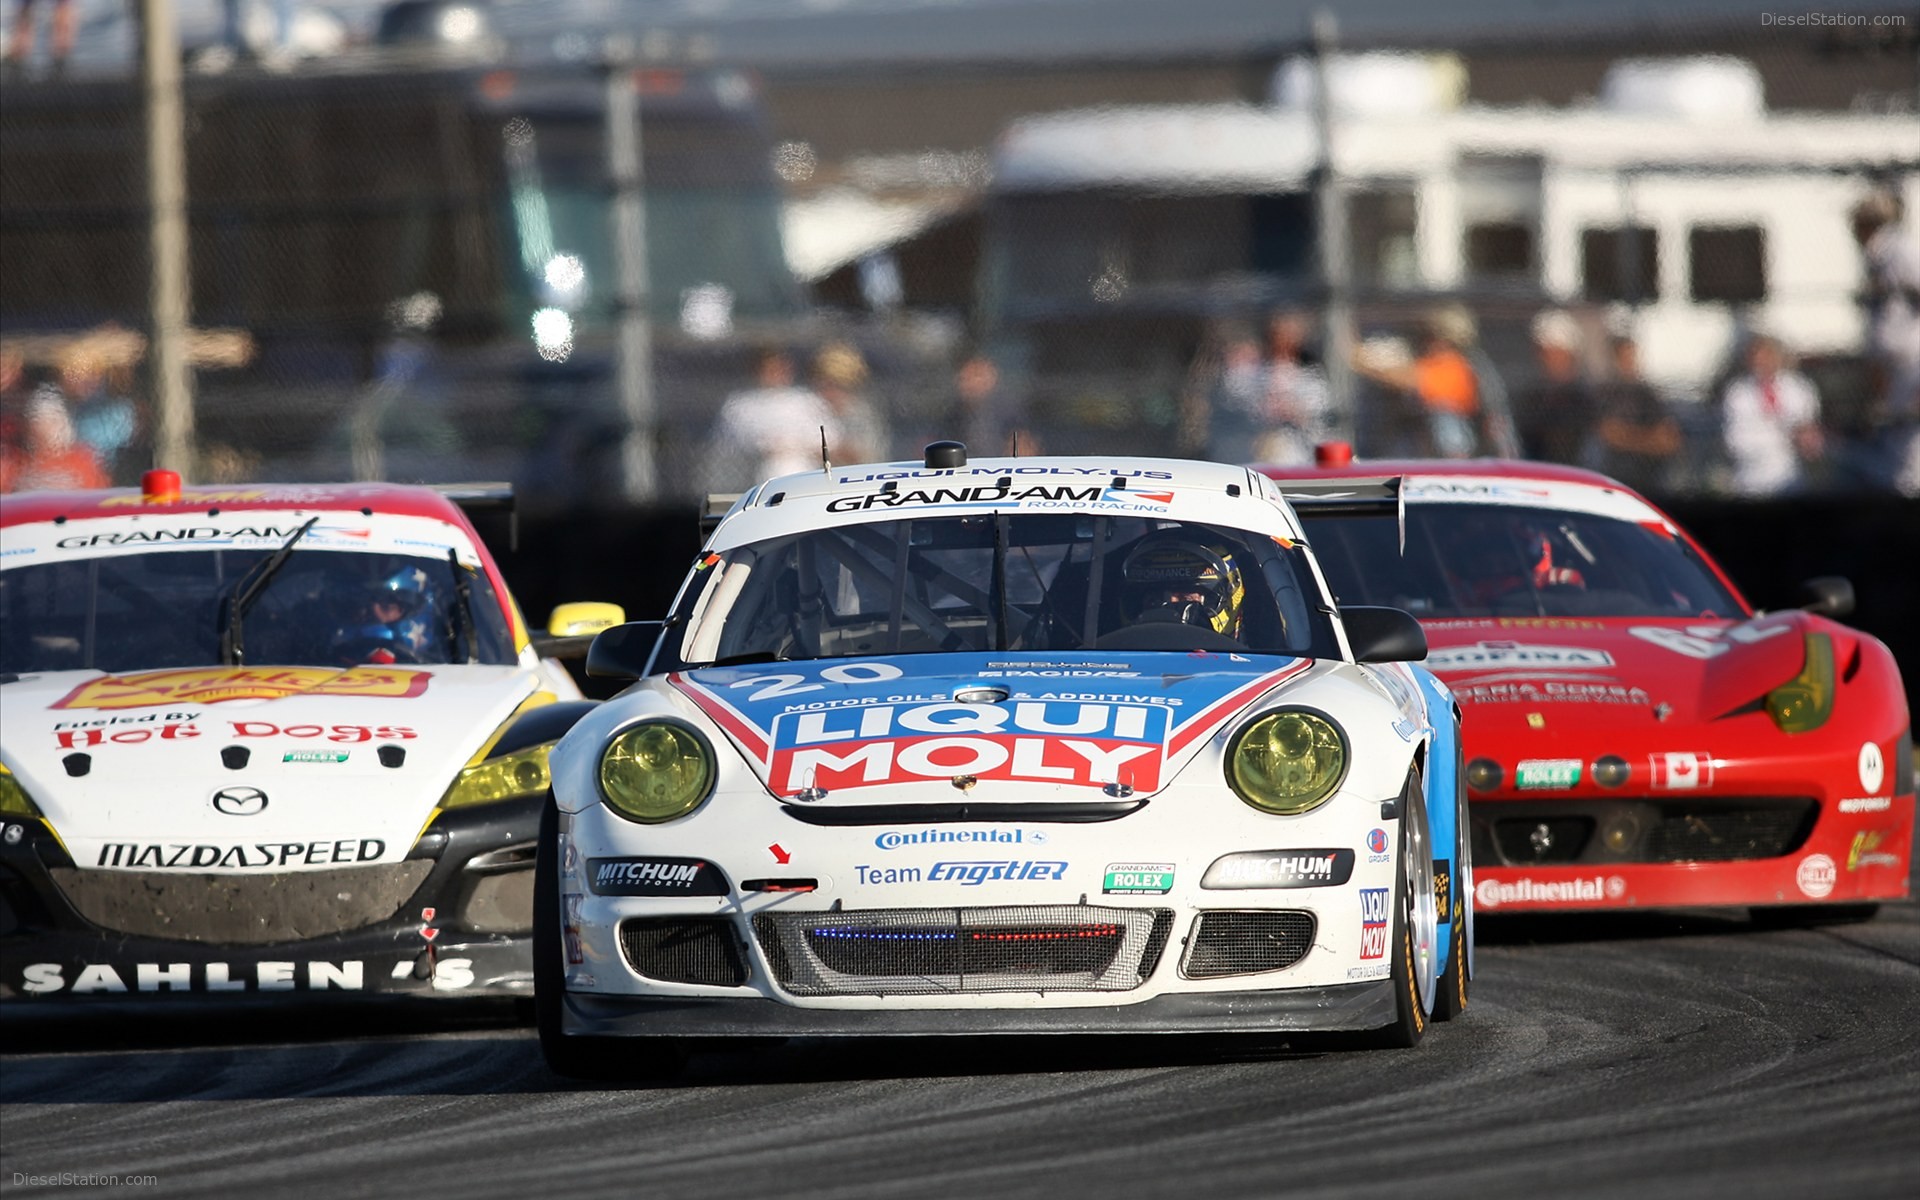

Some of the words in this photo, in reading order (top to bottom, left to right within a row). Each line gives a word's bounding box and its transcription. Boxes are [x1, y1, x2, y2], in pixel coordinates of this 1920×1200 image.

[838, 466, 1173, 485] LIQUI-MOLY.US
[825, 486, 1099, 513] GRAND-AM
[1026, 501, 1087, 509] ROAD
[1090, 501, 1169, 514] RACING
[56, 525, 303, 549] GRAND-AM
[729, 662, 904, 702] 20
[1006, 670, 1093, 678] PAGID
[784, 697, 879, 712] MOTOR
[886, 692, 948, 703] OILS
[1013, 691, 1031, 700] &
[1038, 692, 1184, 707] ADDITIVES
[54, 714, 157, 731] Fueled
[164, 712, 202, 721] By
[227, 721, 419, 743] Dogs
[795, 702, 1150, 745] LIQUI
[292, 752, 338, 762] ROLEX
[787, 738, 1157, 791] MOLY
[1523, 769, 1573, 786] ROLEX
[875, 828, 1023, 850] Continental
[97, 839, 387, 868] MAZDASPEED
[596, 862, 700, 882] MITCHUM
[854, 865, 922, 885] Team
[1221, 857, 1332, 876] MITCHUM
[595, 878, 693, 888] MOTORSPORTS
[1113, 873, 1164, 887] ROLEX
[1475, 876, 1604, 907] Continental
[1360, 890, 1389, 922] LIQUI
[1361, 926, 1387, 958] MOLY
